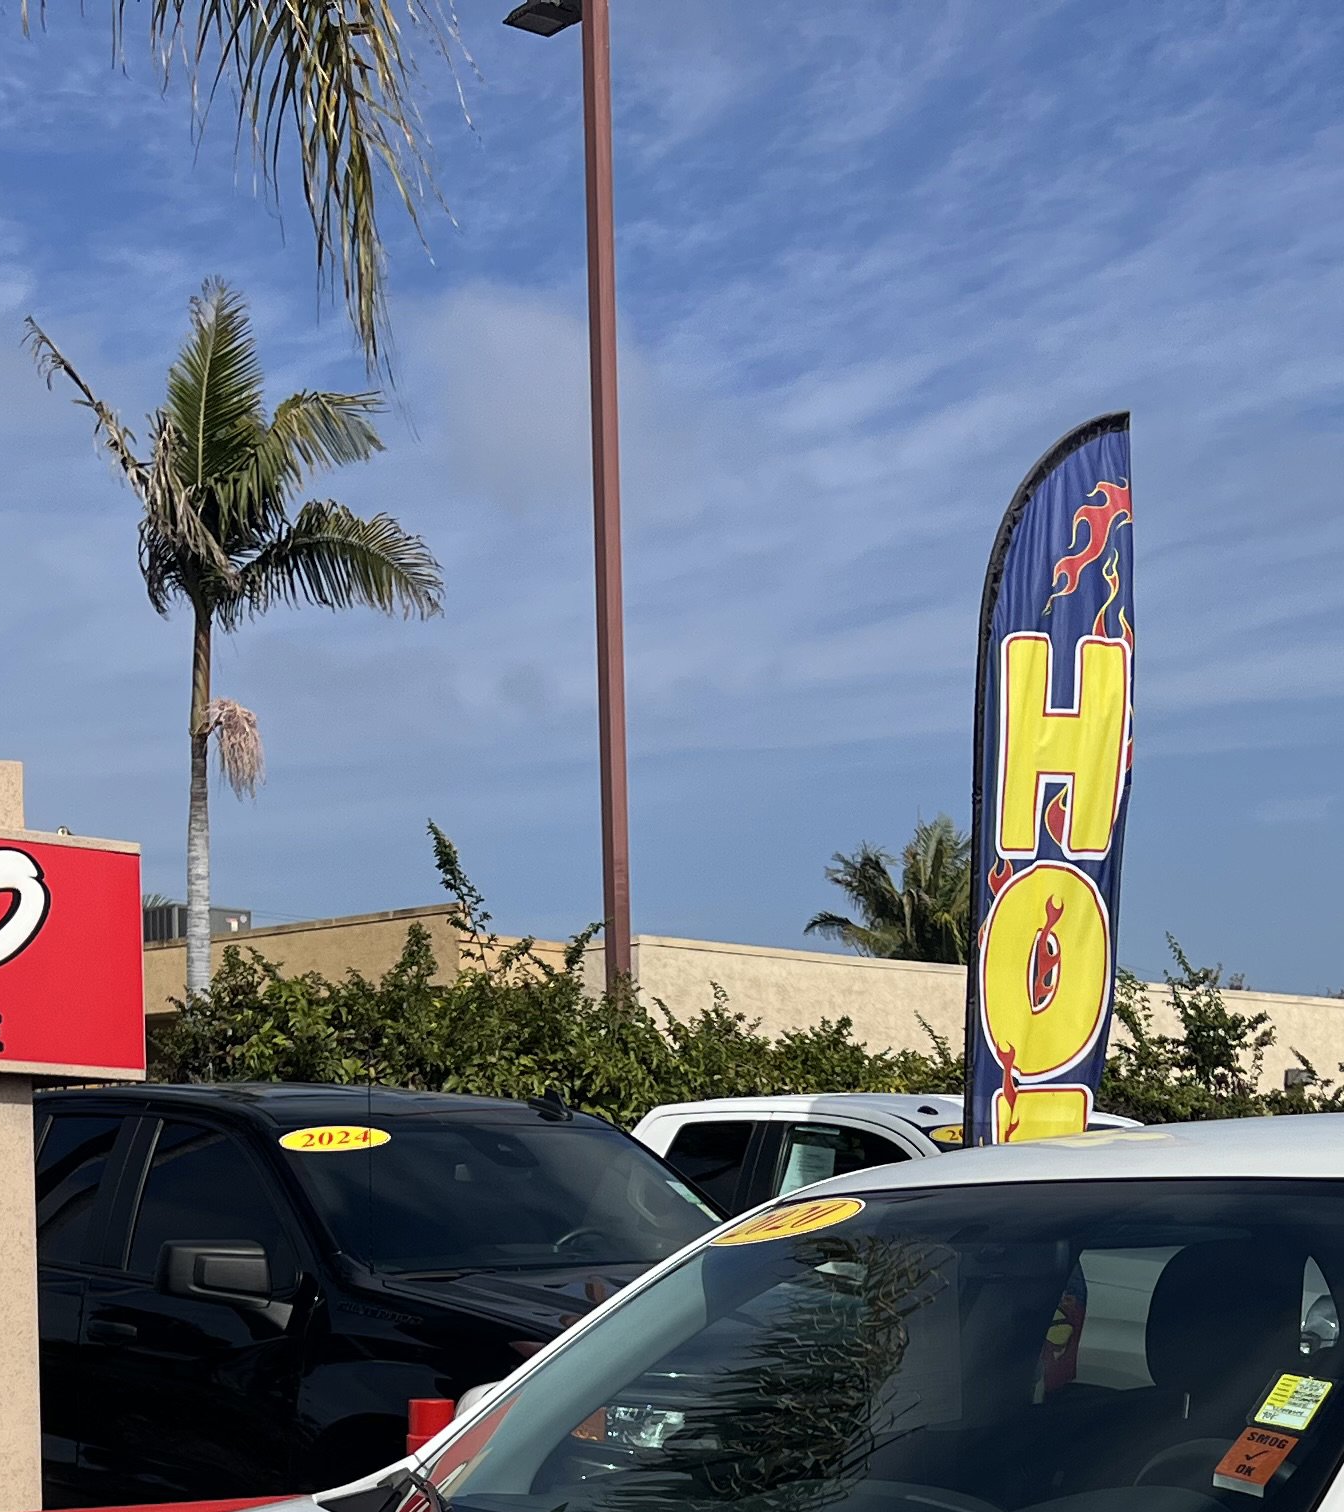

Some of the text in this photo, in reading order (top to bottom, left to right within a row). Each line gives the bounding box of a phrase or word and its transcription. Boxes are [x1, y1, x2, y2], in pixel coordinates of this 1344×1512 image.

[978, 631, 1133, 1144] HO
[302, 1130, 369, 1148] 2024
[1247, 1432, 1289, 1450] SMOG
[1235, 1464, 1255, 1477] OK
